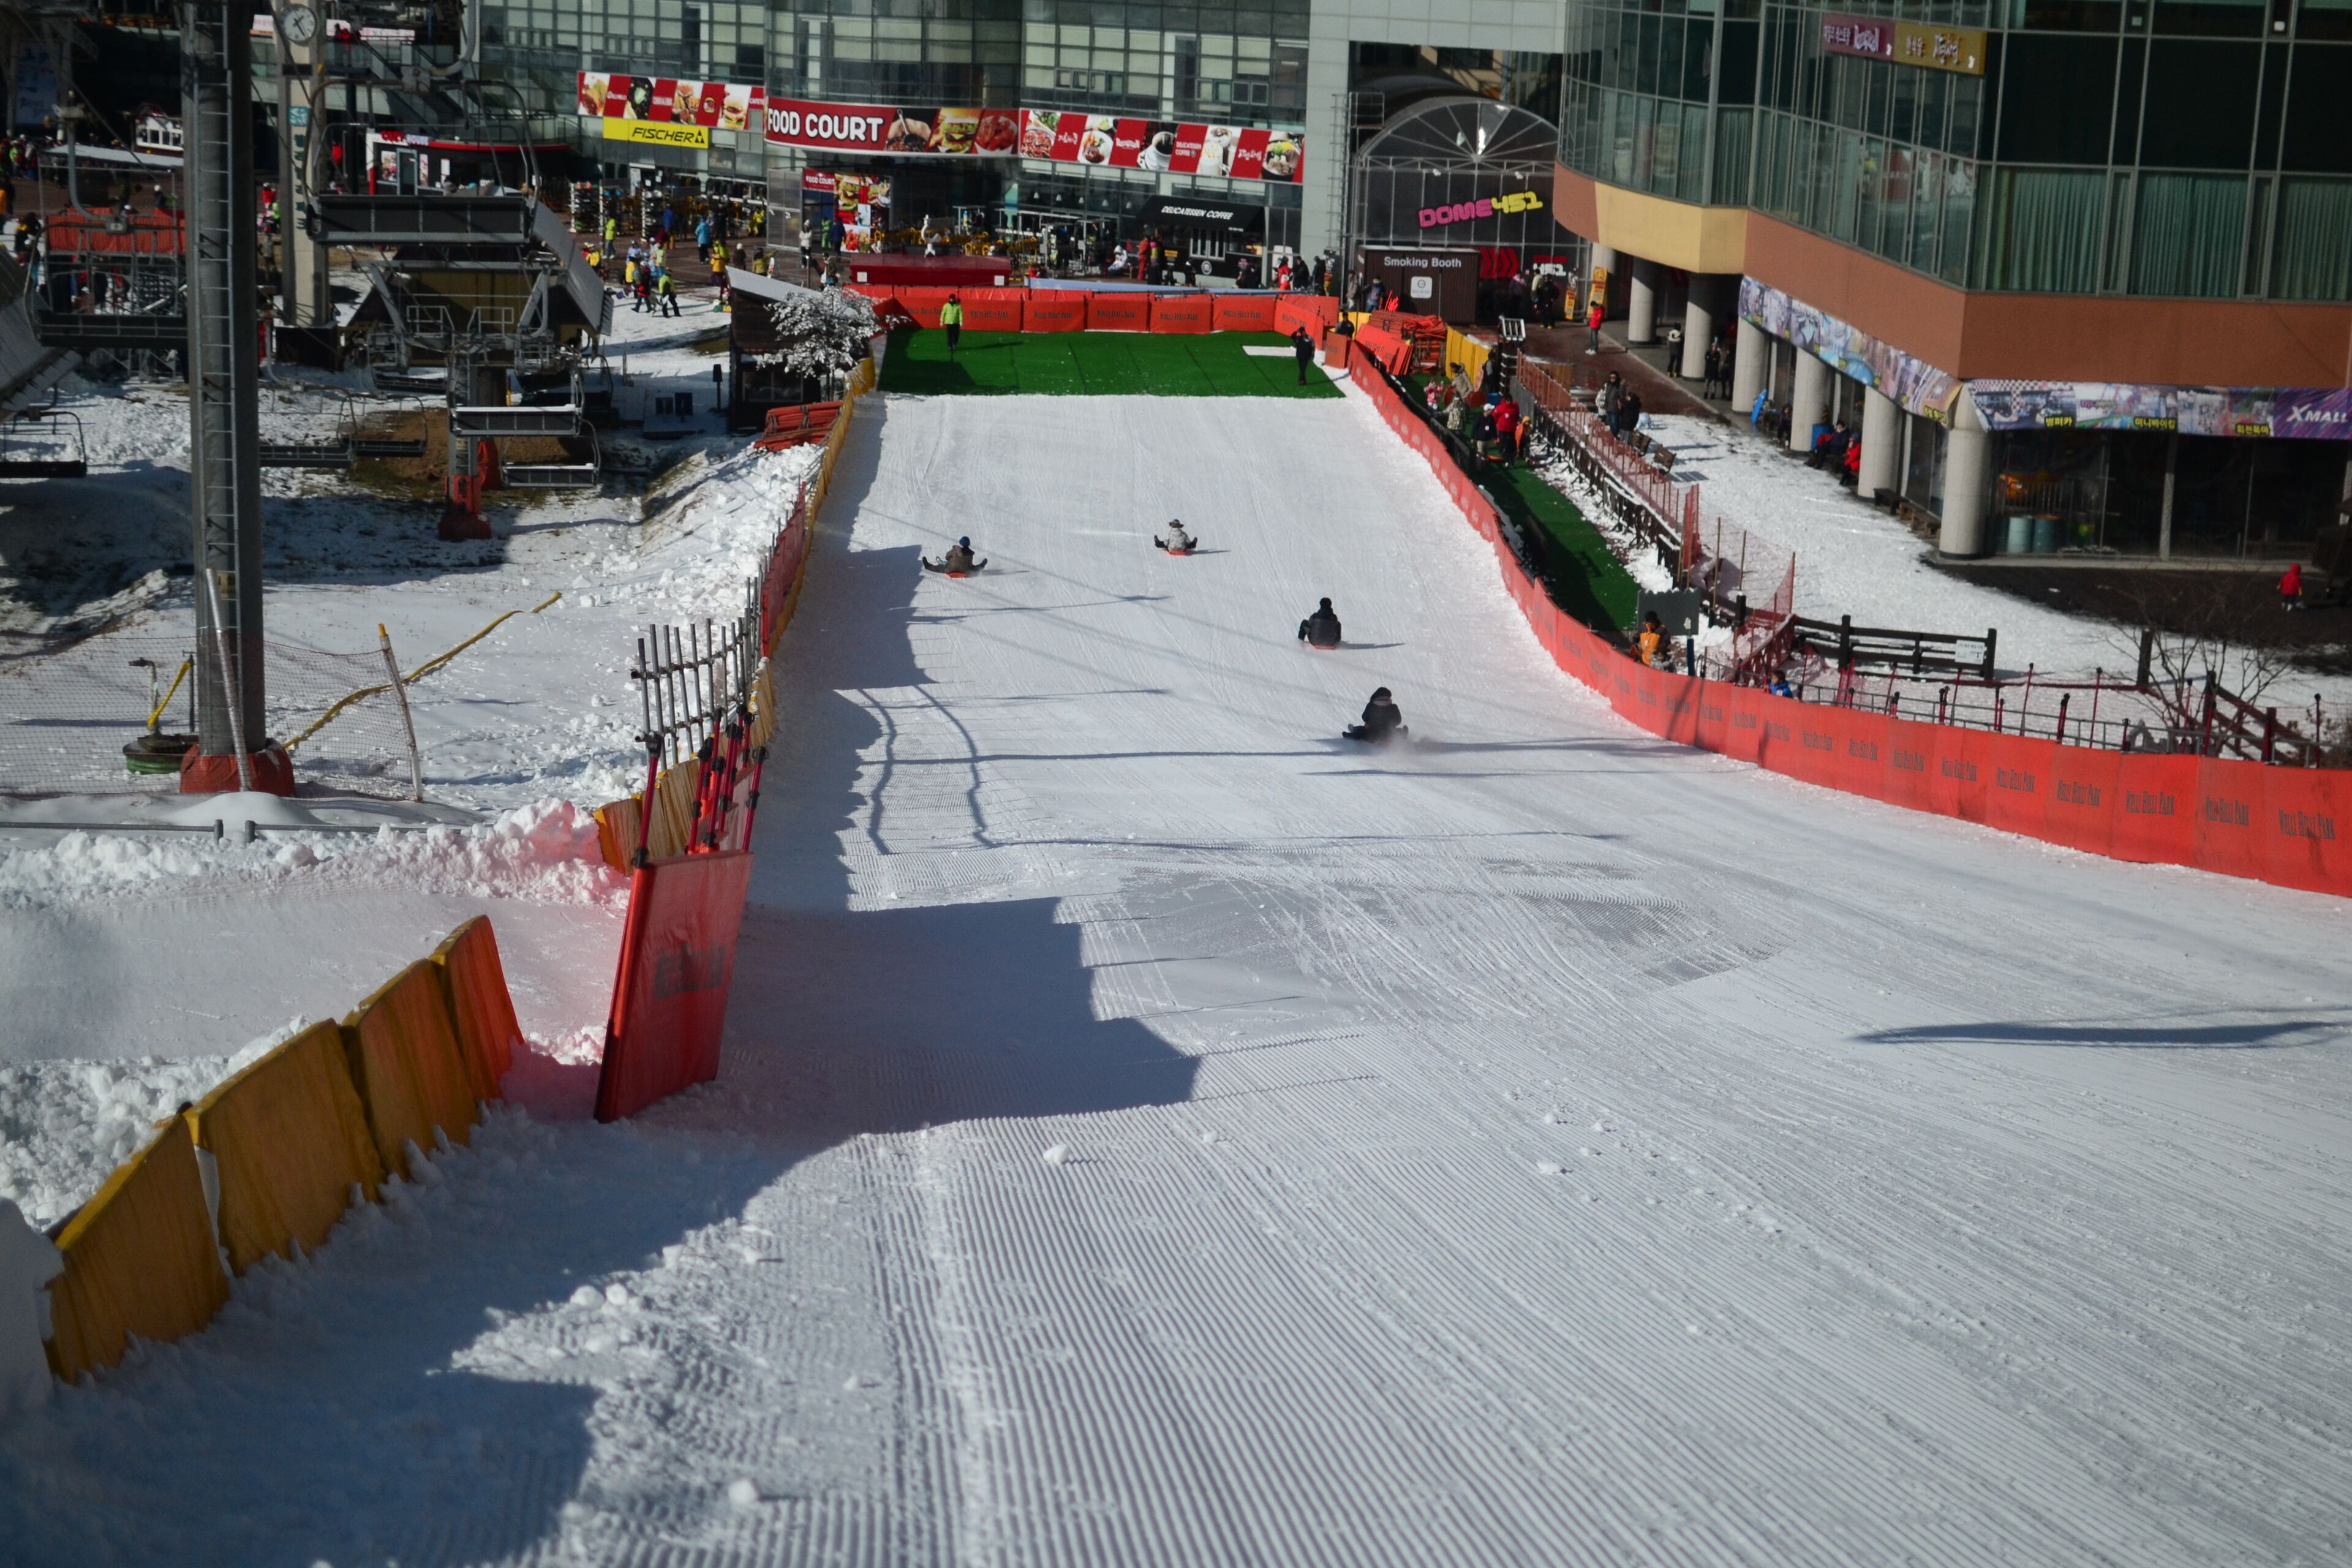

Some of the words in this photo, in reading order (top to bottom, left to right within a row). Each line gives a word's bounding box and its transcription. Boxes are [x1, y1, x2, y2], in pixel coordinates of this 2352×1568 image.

[767, 108, 801, 136] FOOD
[805, 113, 883, 142] COURT
[632, 127, 695, 143] FISCHER
[805, 175, 819, 184] FOOD
[1161, 205, 1207, 217] DELICATESSEN
[1206, 210, 1234, 220] COFFEE
[1419, 190, 1544, 228] DOME451
[1384, 256, 1428, 268] Smoking
[1431, 257, 1462, 268] Booth
[2045, 416, 2073, 427] 범퍼카
[2286, 404, 2347, 423] XMALL
[2135, 417, 2176, 430] 미니바이킹
[2159, 791, 2176, 815] PARK
[2316, 813, 2335, 840] PARK
